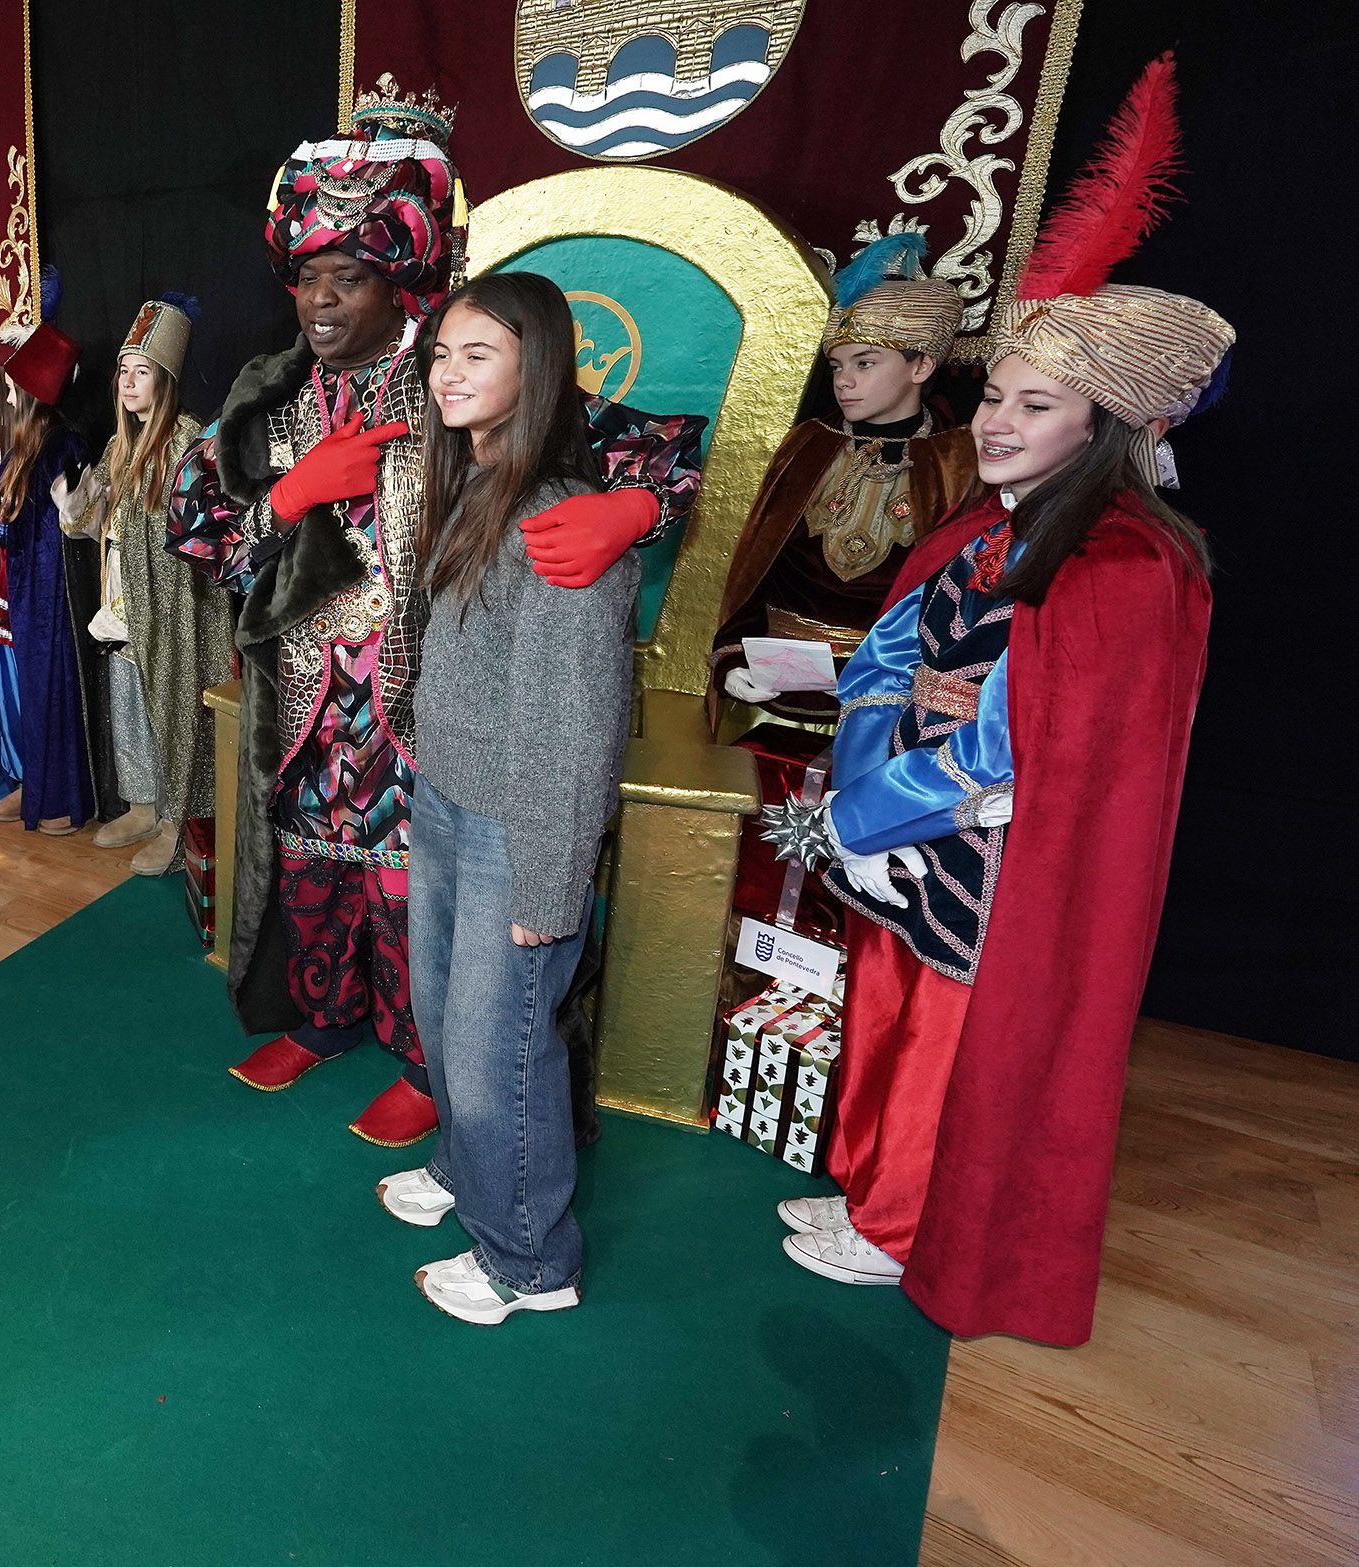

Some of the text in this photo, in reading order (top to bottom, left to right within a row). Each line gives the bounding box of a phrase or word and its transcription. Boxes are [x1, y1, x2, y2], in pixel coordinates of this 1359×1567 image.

[777, 947, 804, 962] Concello
[775, 954, 820, 976] de Pontevedra
